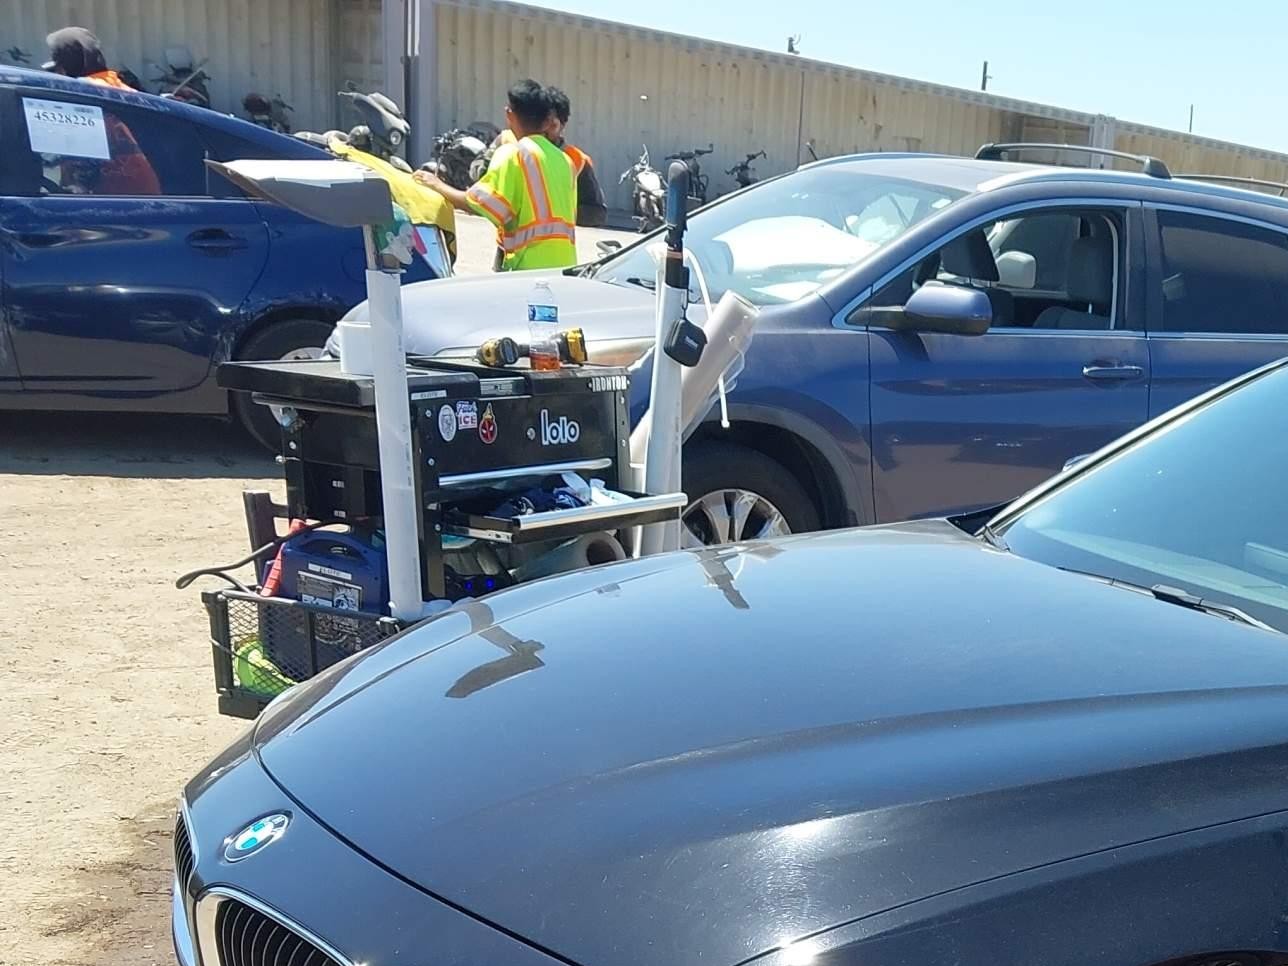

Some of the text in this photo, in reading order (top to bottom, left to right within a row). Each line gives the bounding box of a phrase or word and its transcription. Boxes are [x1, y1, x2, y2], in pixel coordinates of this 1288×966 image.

[34, 112, 95, 126] 45328226
[592, 375, 627, 392] IRONTON
[459, 415, 477, 425] ICE
